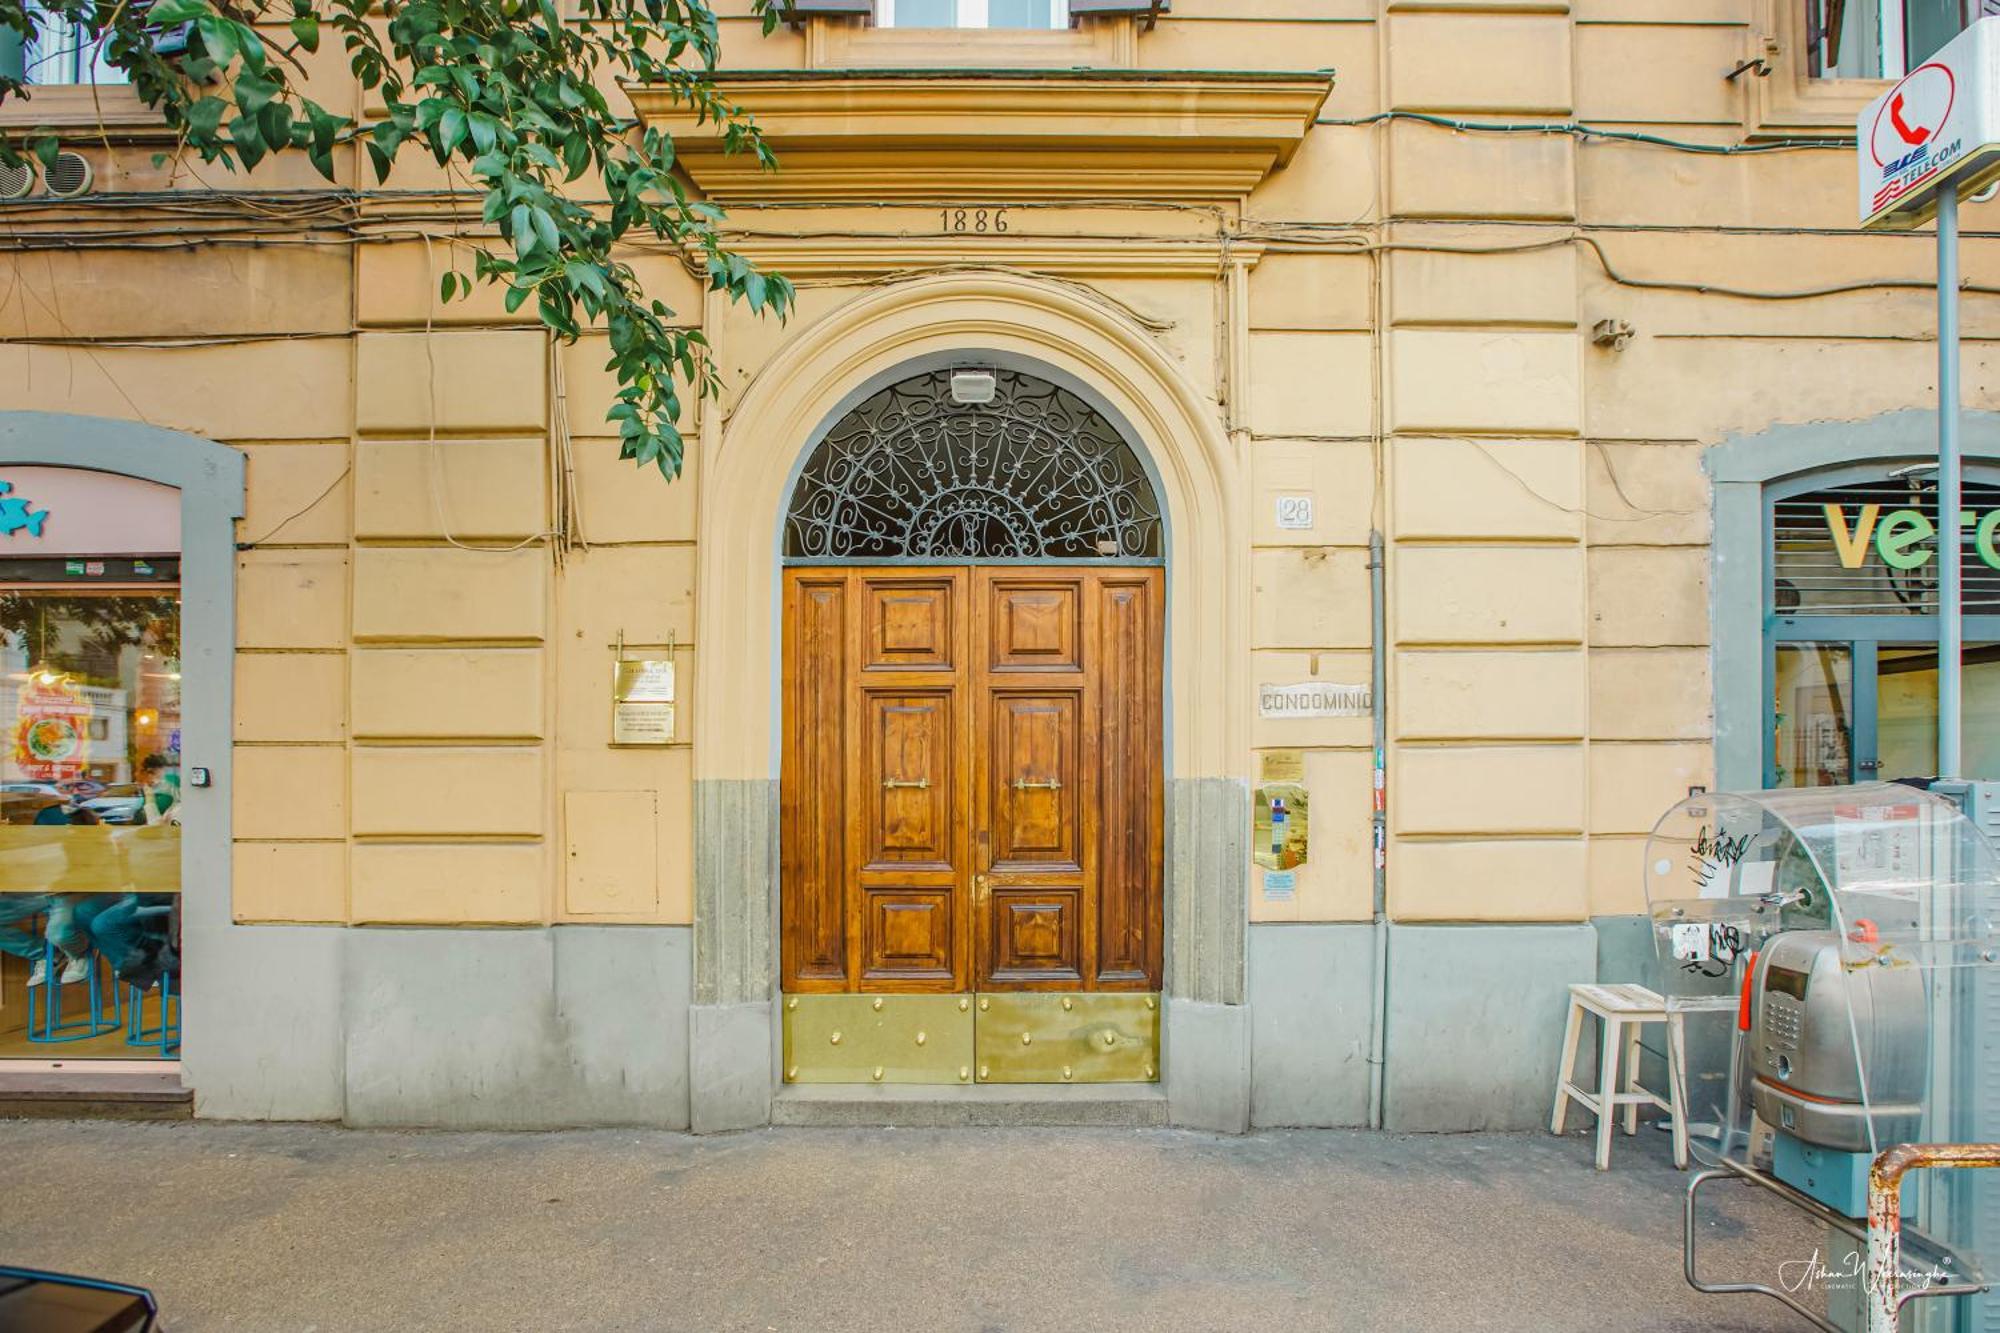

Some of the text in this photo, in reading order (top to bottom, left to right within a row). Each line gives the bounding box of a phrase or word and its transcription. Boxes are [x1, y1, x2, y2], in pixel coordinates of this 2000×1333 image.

[1903, 138, 1962, 186] TELECOM
[940, 209, 1008, 233] 1886
[1283, 499, 1309, 522] 28
[1262, 693, 1373, 710] CONDOMINIO
